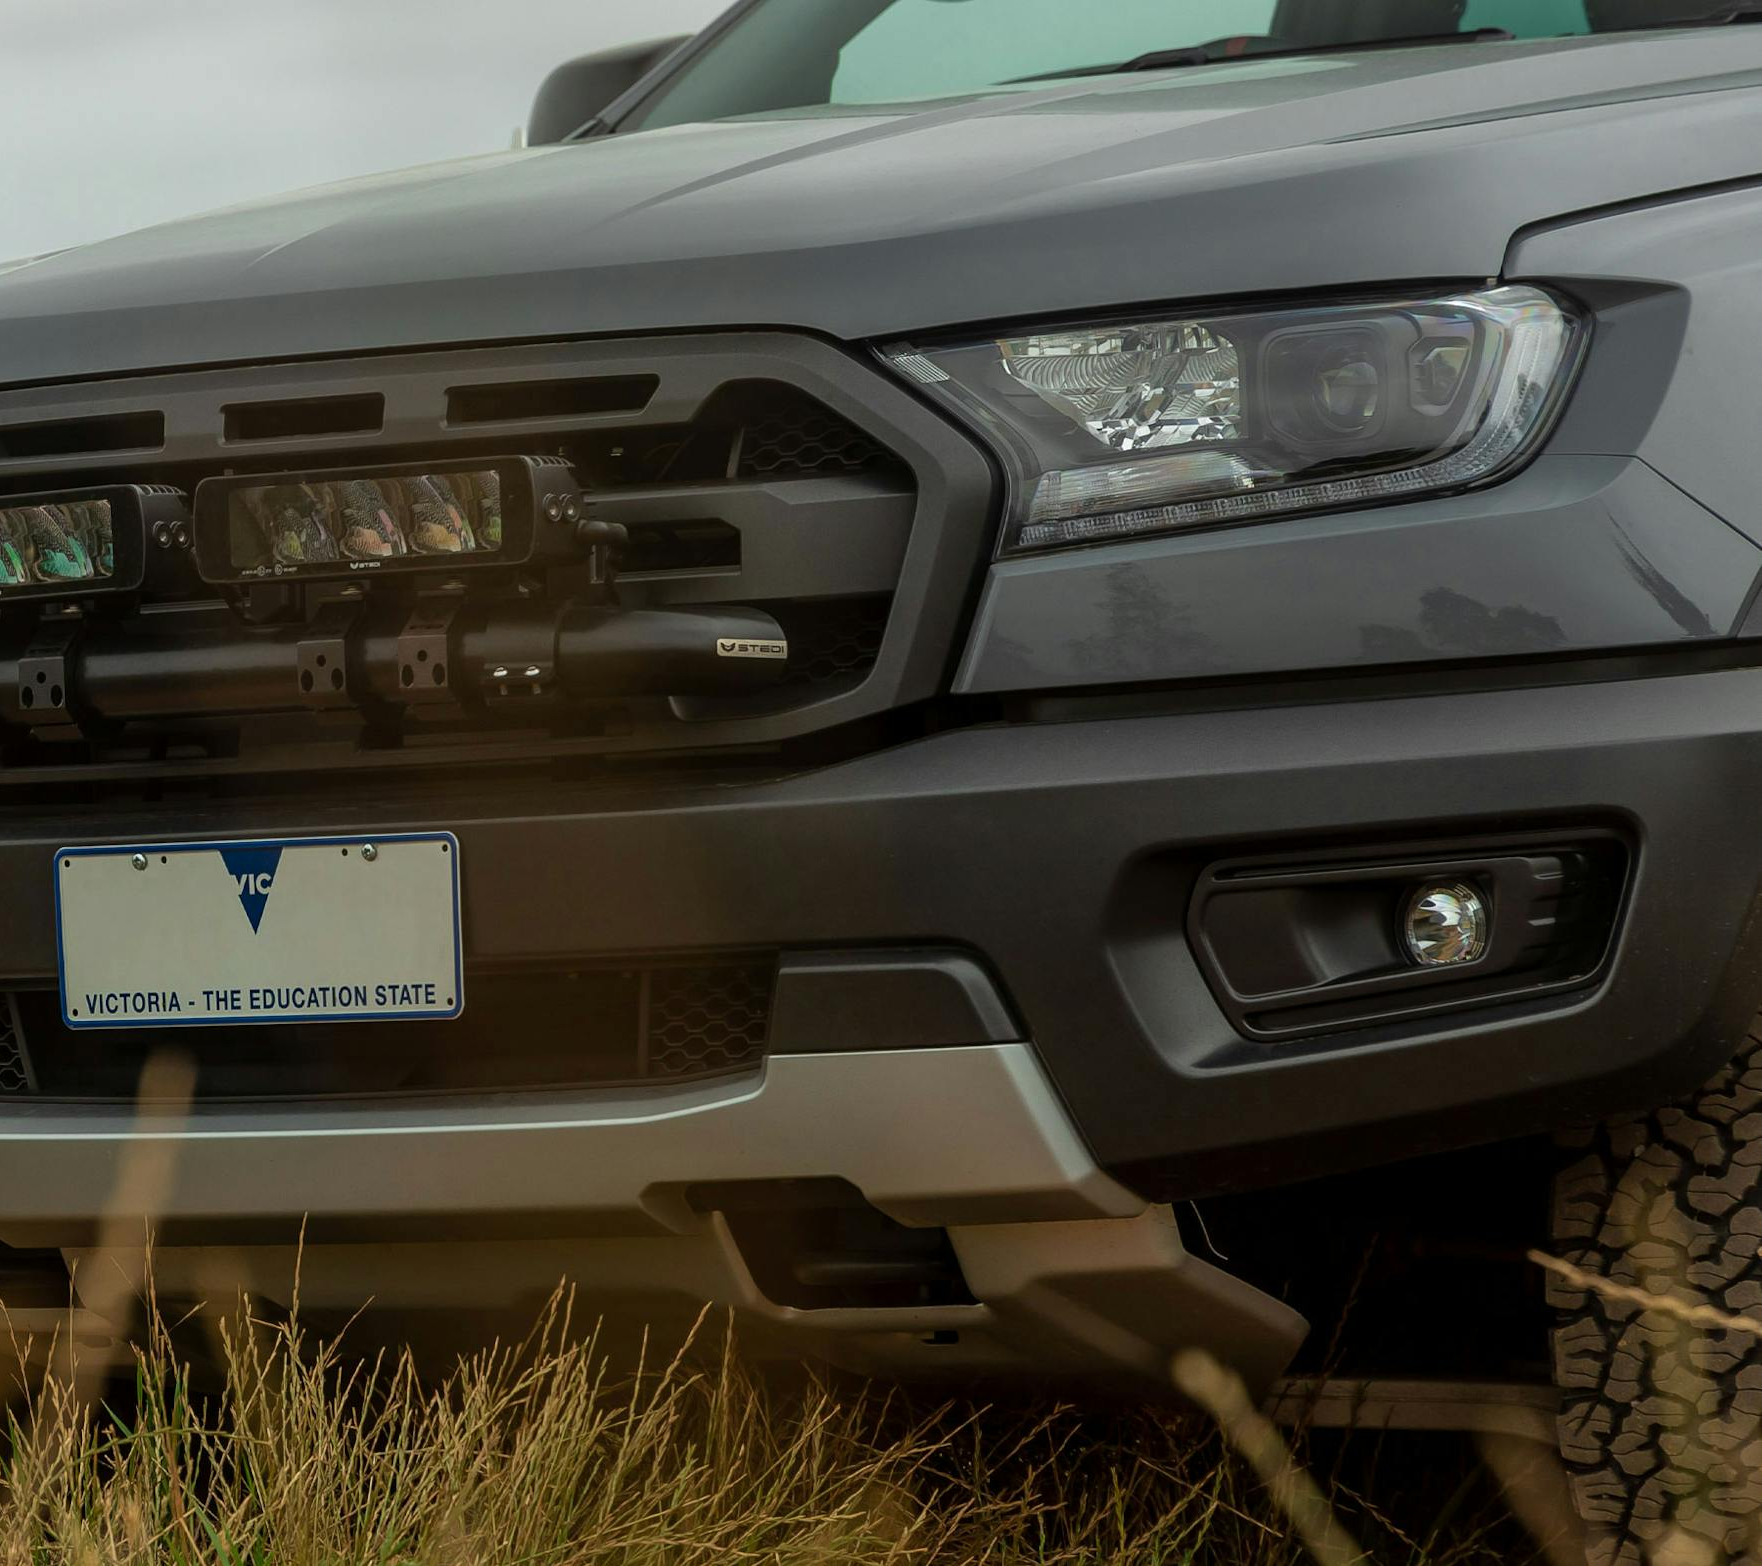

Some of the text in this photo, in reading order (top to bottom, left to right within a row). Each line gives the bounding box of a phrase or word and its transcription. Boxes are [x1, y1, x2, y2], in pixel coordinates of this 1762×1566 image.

[738, 644, 784, 653] STEDI
[231, 873, 271, 895] VIC
[86, 992, 181, 1014] VICTORIA
[202, 990, 242, 1011] THE
[249, 986, 367, 1010] EDUCATION
[375, 983, 436, 1006] STATE
